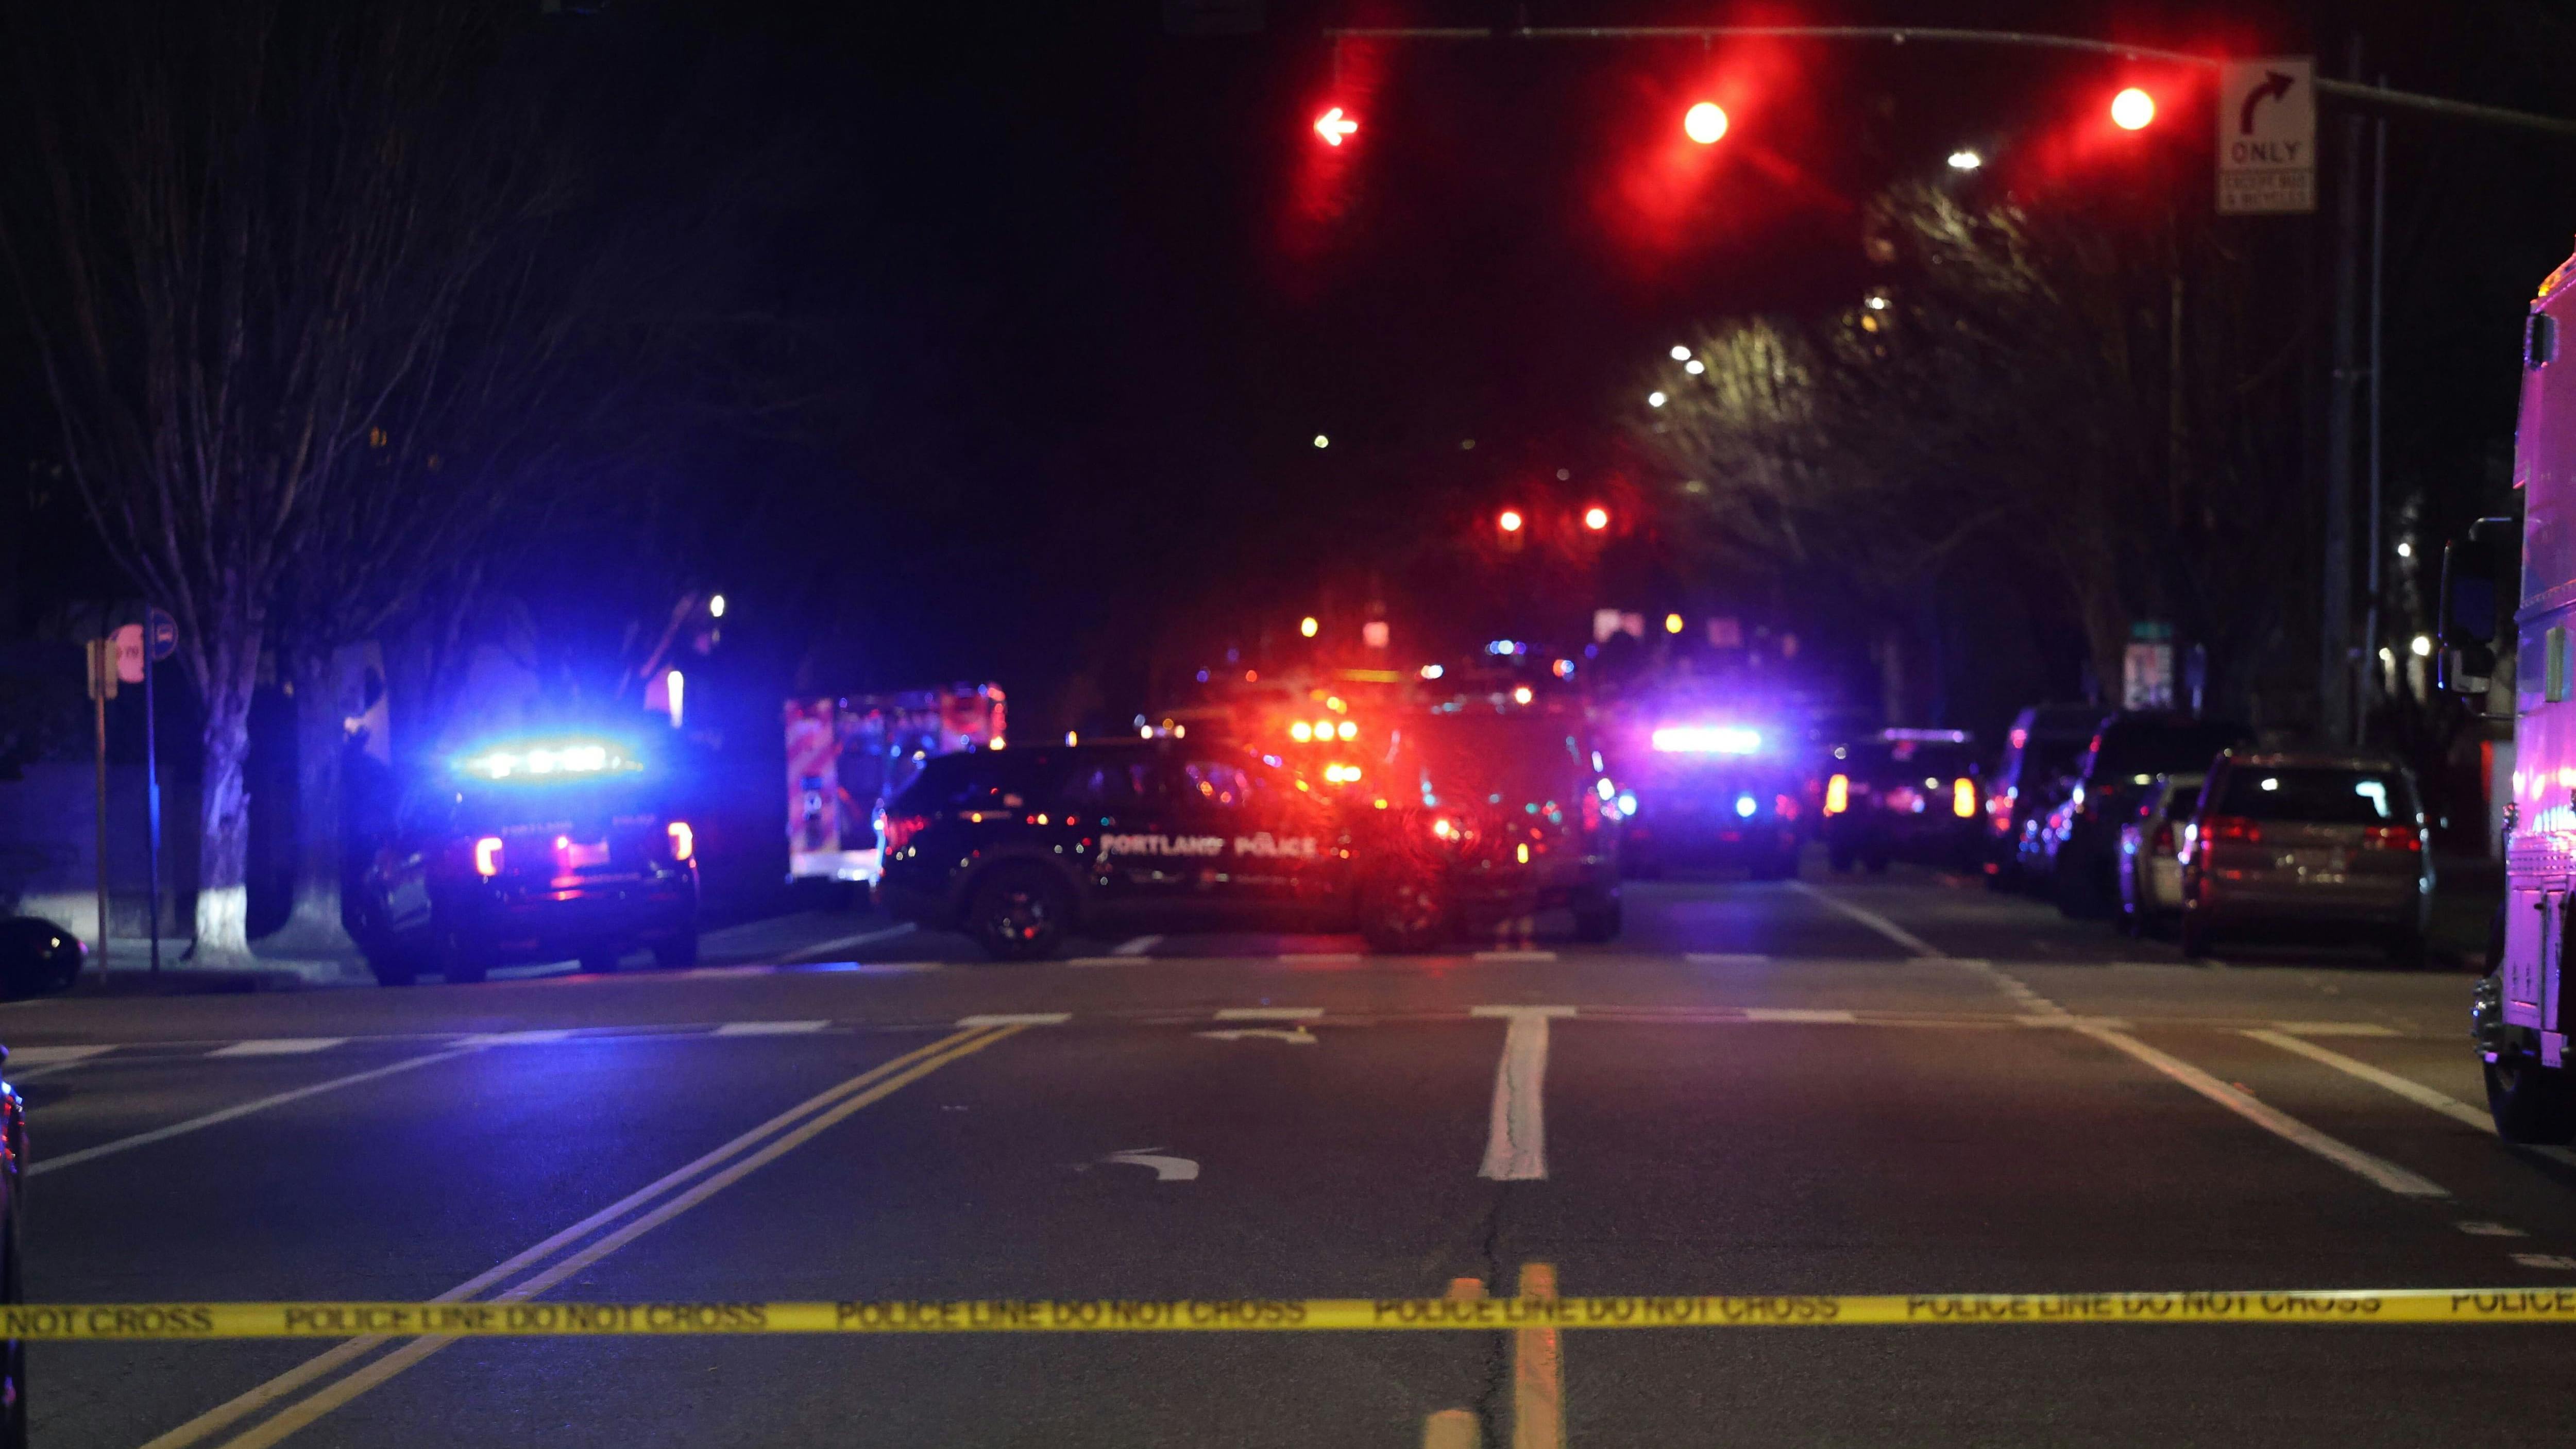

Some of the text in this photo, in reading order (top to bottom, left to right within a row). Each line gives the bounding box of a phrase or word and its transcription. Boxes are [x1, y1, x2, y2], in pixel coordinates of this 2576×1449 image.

[2231, 140, 2302, 164] ONLY
[1100, 833, 1318, 857] PORTLAND POLICE
[6, 1309, 75, 1334] NOT
[88, 1307, 213, 1333] CROSS
[286, 1308, 413, 1330] POLICE
[421, 1306, 499, 1329] LINE
[507, 1305, 556, 1328] DO
[566, 1305, 635, 1328] NOT
[647, 1304, 767, 1328] CROSS
[837, 1302, 961, 1327] POLICE
[969, 1302, 1045, 1326] LINE
[1056, 1301, 1103, 1325] DO
[1111, 1301, 1179, 1325] NOT
[1188, 1301, 1306, 1324] CROSS
[1376, 1300, 1496, 1322] POLICE
[1505, 1299, 1578, 1321] LINE
[1587, 1299, 1634, 1321] DO
[1641, 1298, 1711, 1320] NOT
[1720, 1297, 1839, 1318] CROSS
[1908, 1296, 2029, 1316] POLICE
[2039, 1296, 2111, 1316] LINE
[2122, 1295, 2172, 1315] DO
[2182, 1294, 2249, 1313] NOT
[2451, 1293, 2575, 1312] POLICE
